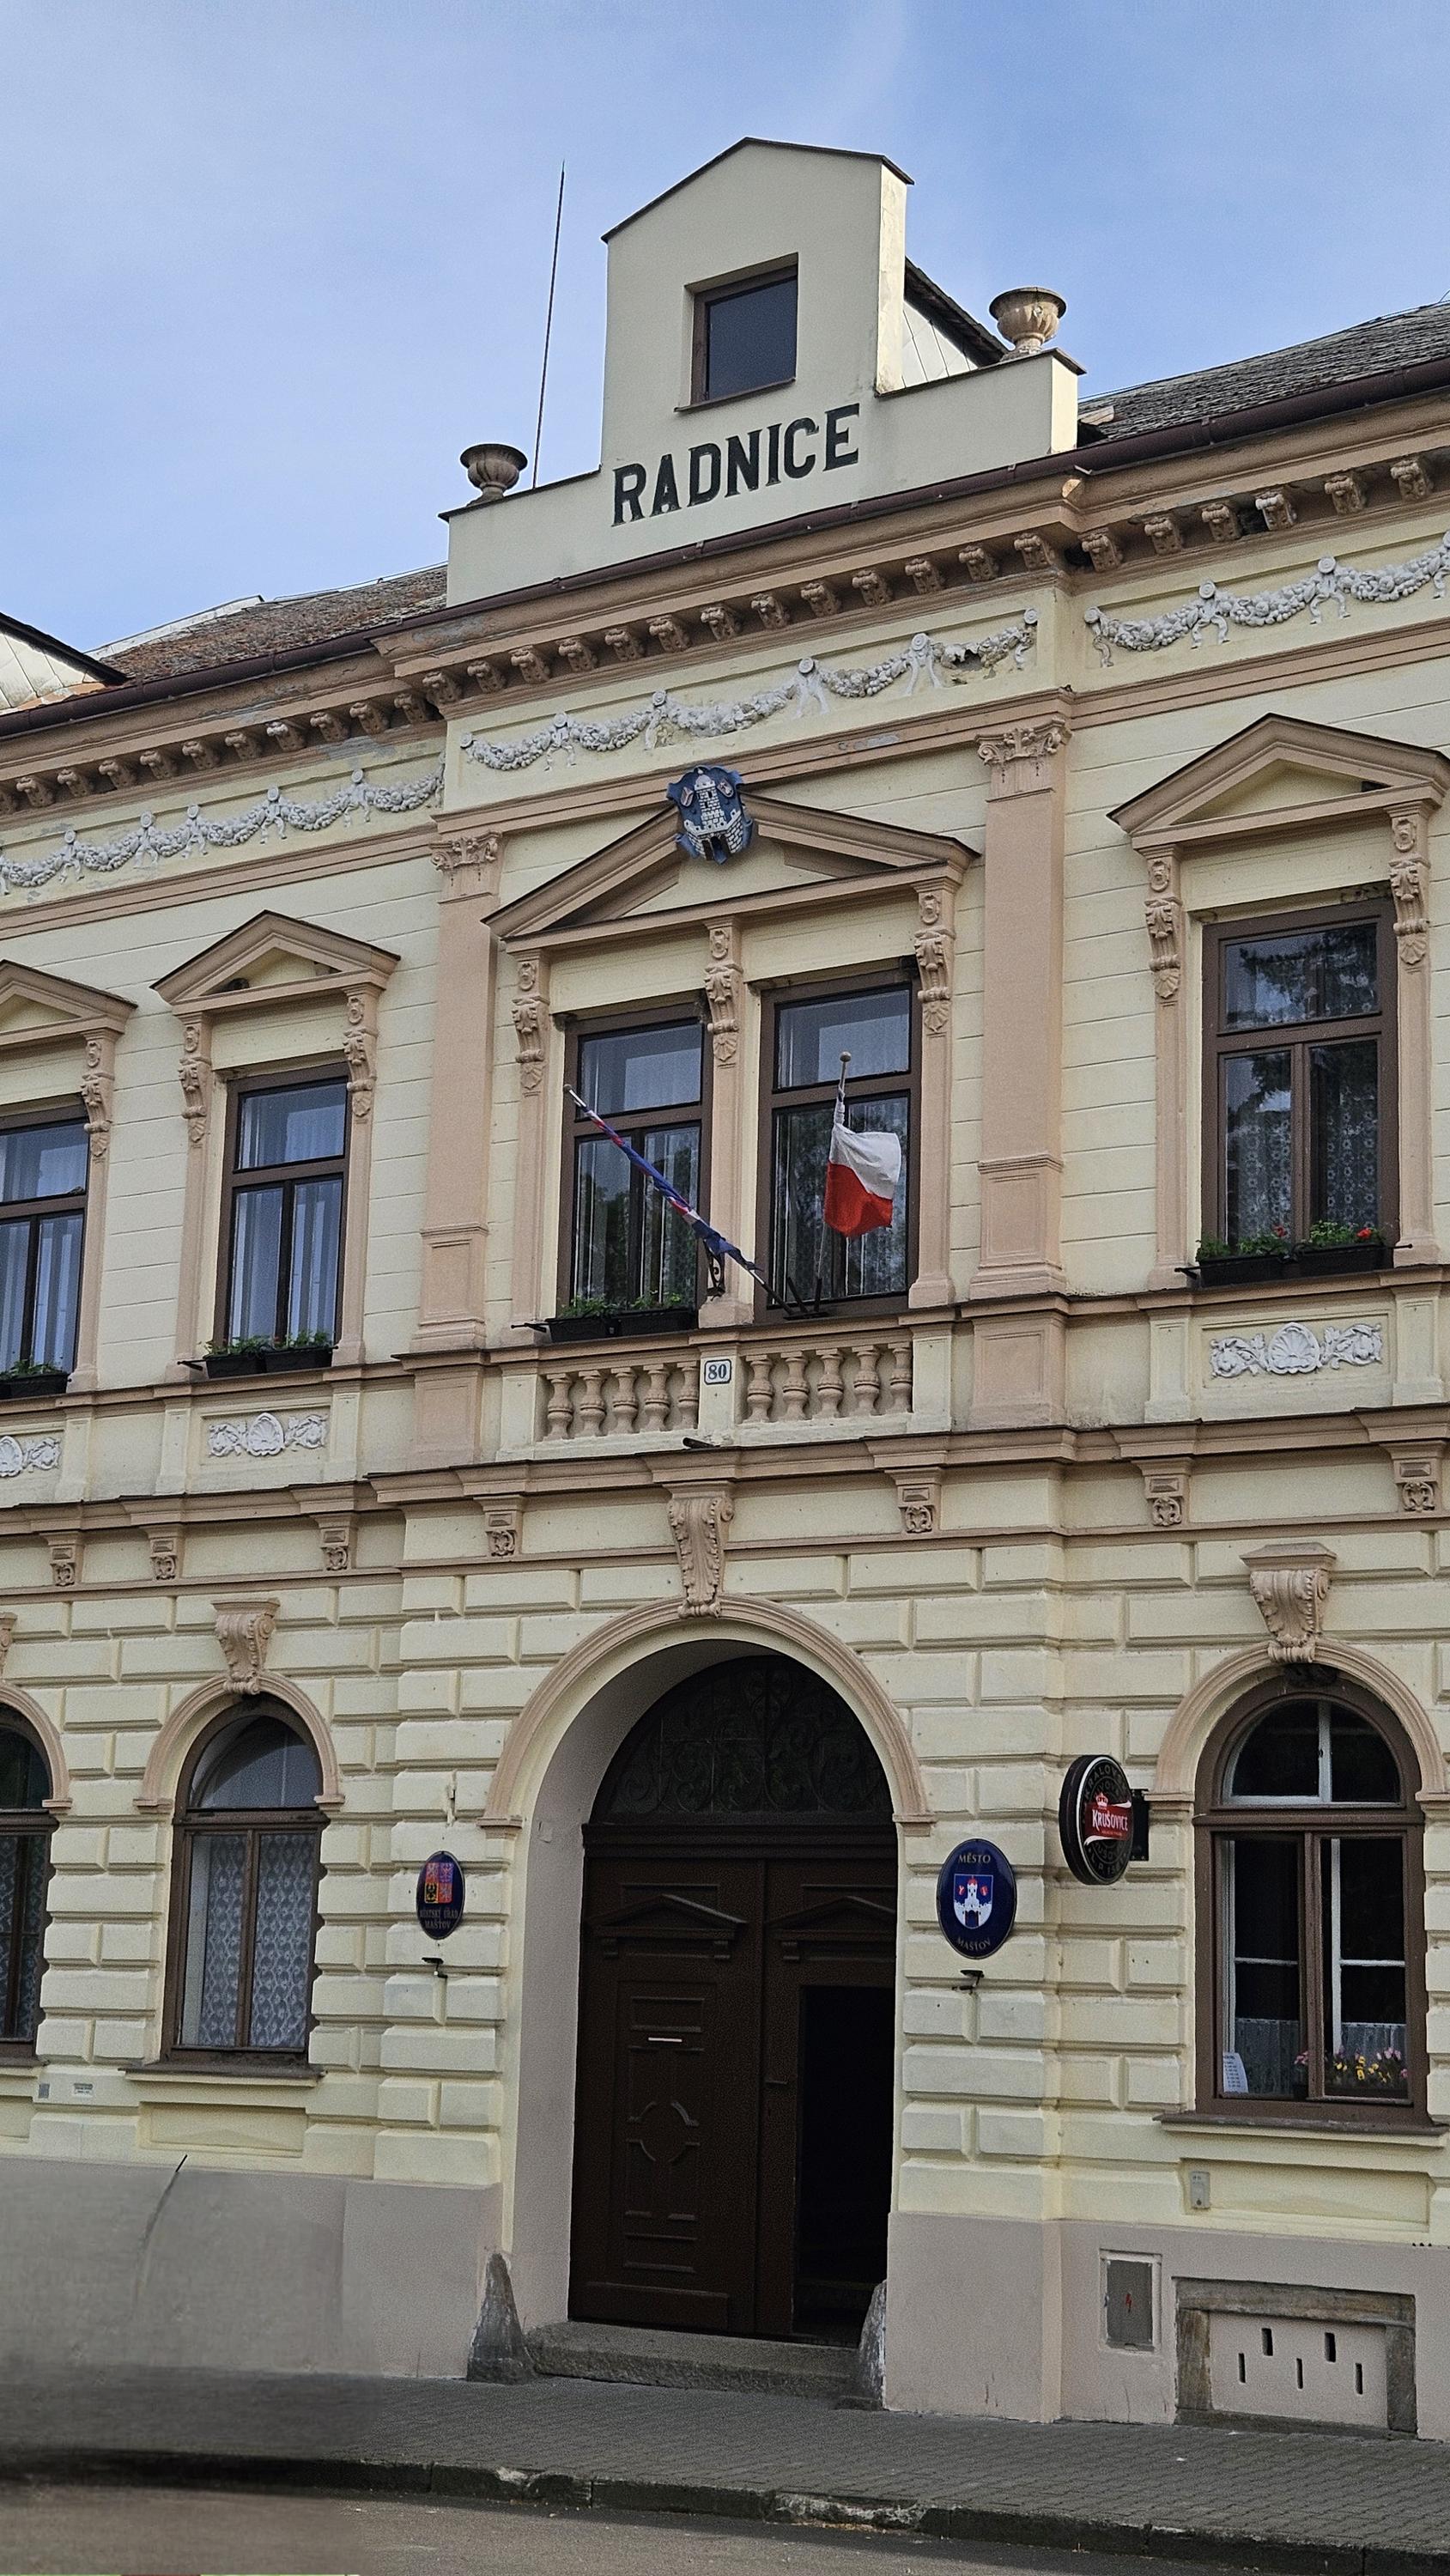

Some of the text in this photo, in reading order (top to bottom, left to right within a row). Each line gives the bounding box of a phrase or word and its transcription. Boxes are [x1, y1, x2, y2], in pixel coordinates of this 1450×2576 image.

[610, 402, 859, 527] RADNICE
[708, 1364, 727, 1380] 80
[1092, 1809, 1128, 1832] KRUŠOVICE
[956, 1852, 991, 1863] MĚSTO
